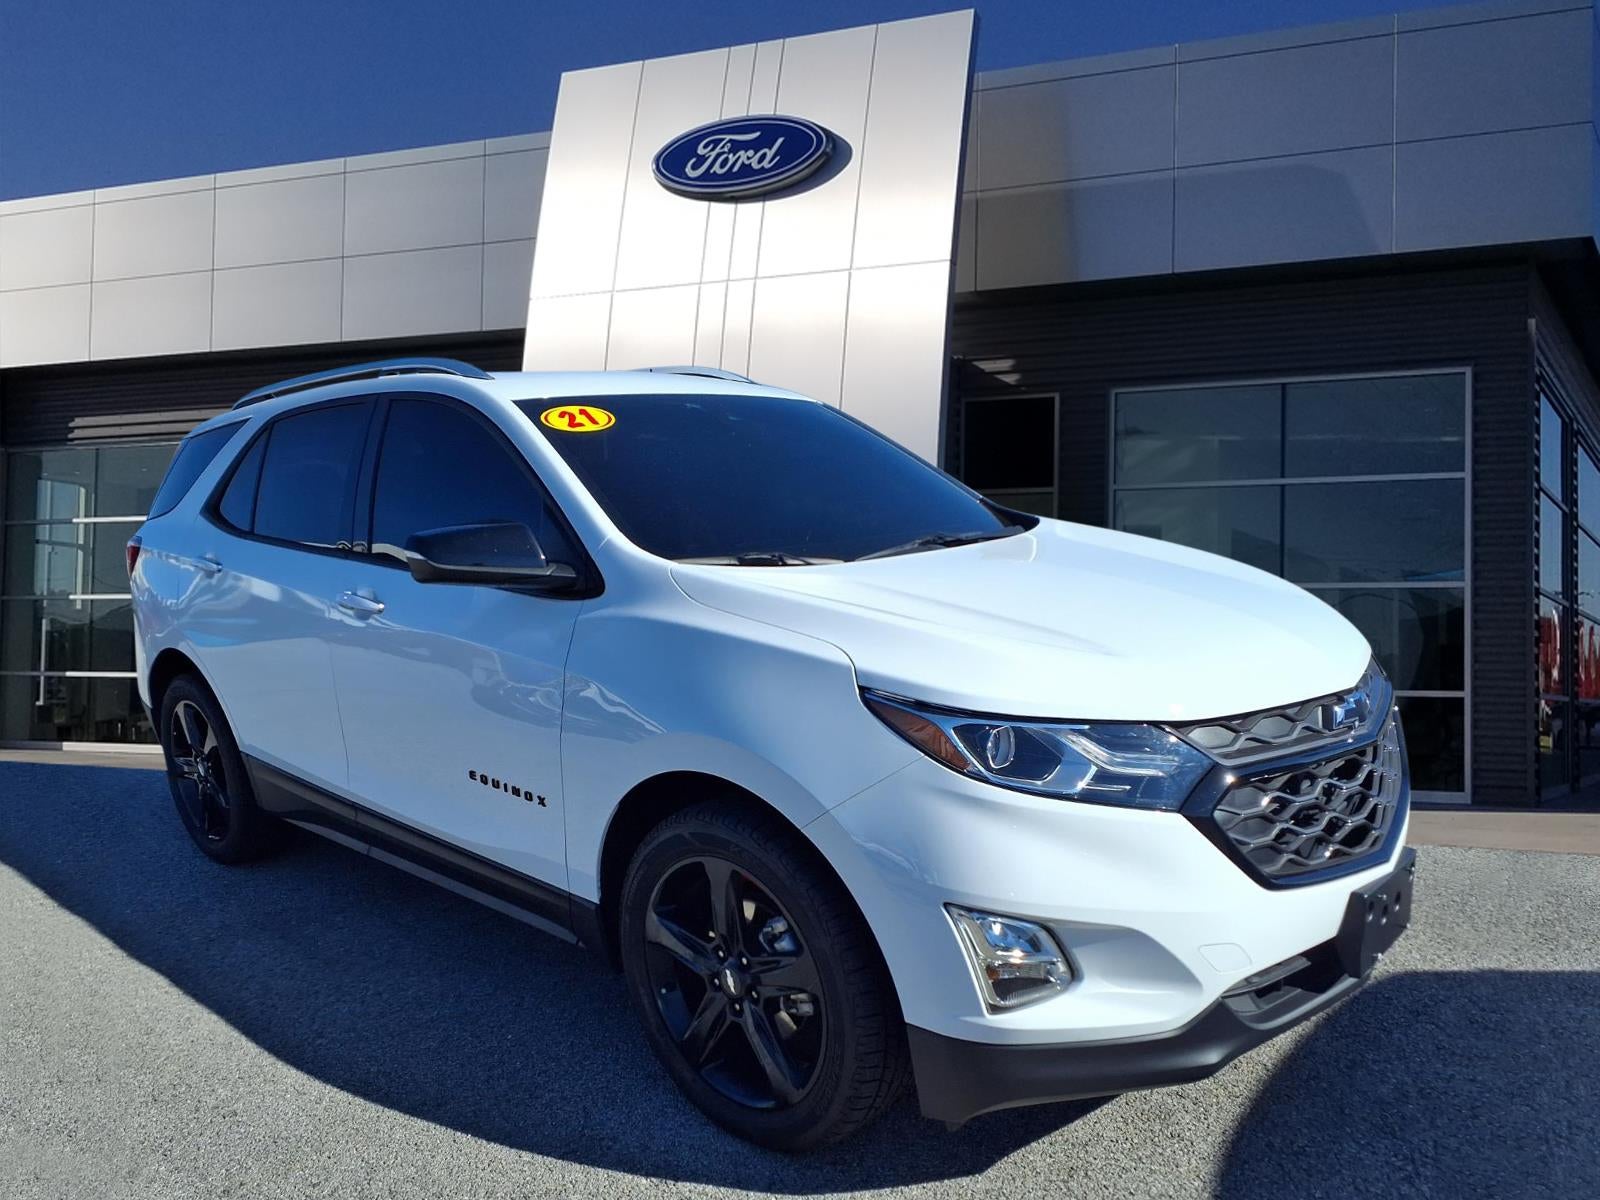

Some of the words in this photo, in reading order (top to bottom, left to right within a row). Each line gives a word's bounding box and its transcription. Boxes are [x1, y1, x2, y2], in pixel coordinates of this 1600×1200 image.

[685, 131, 785, 178] Ford
[558, 408, 600, 428] 21
[468, 769, 547, 808] EQUINOX
